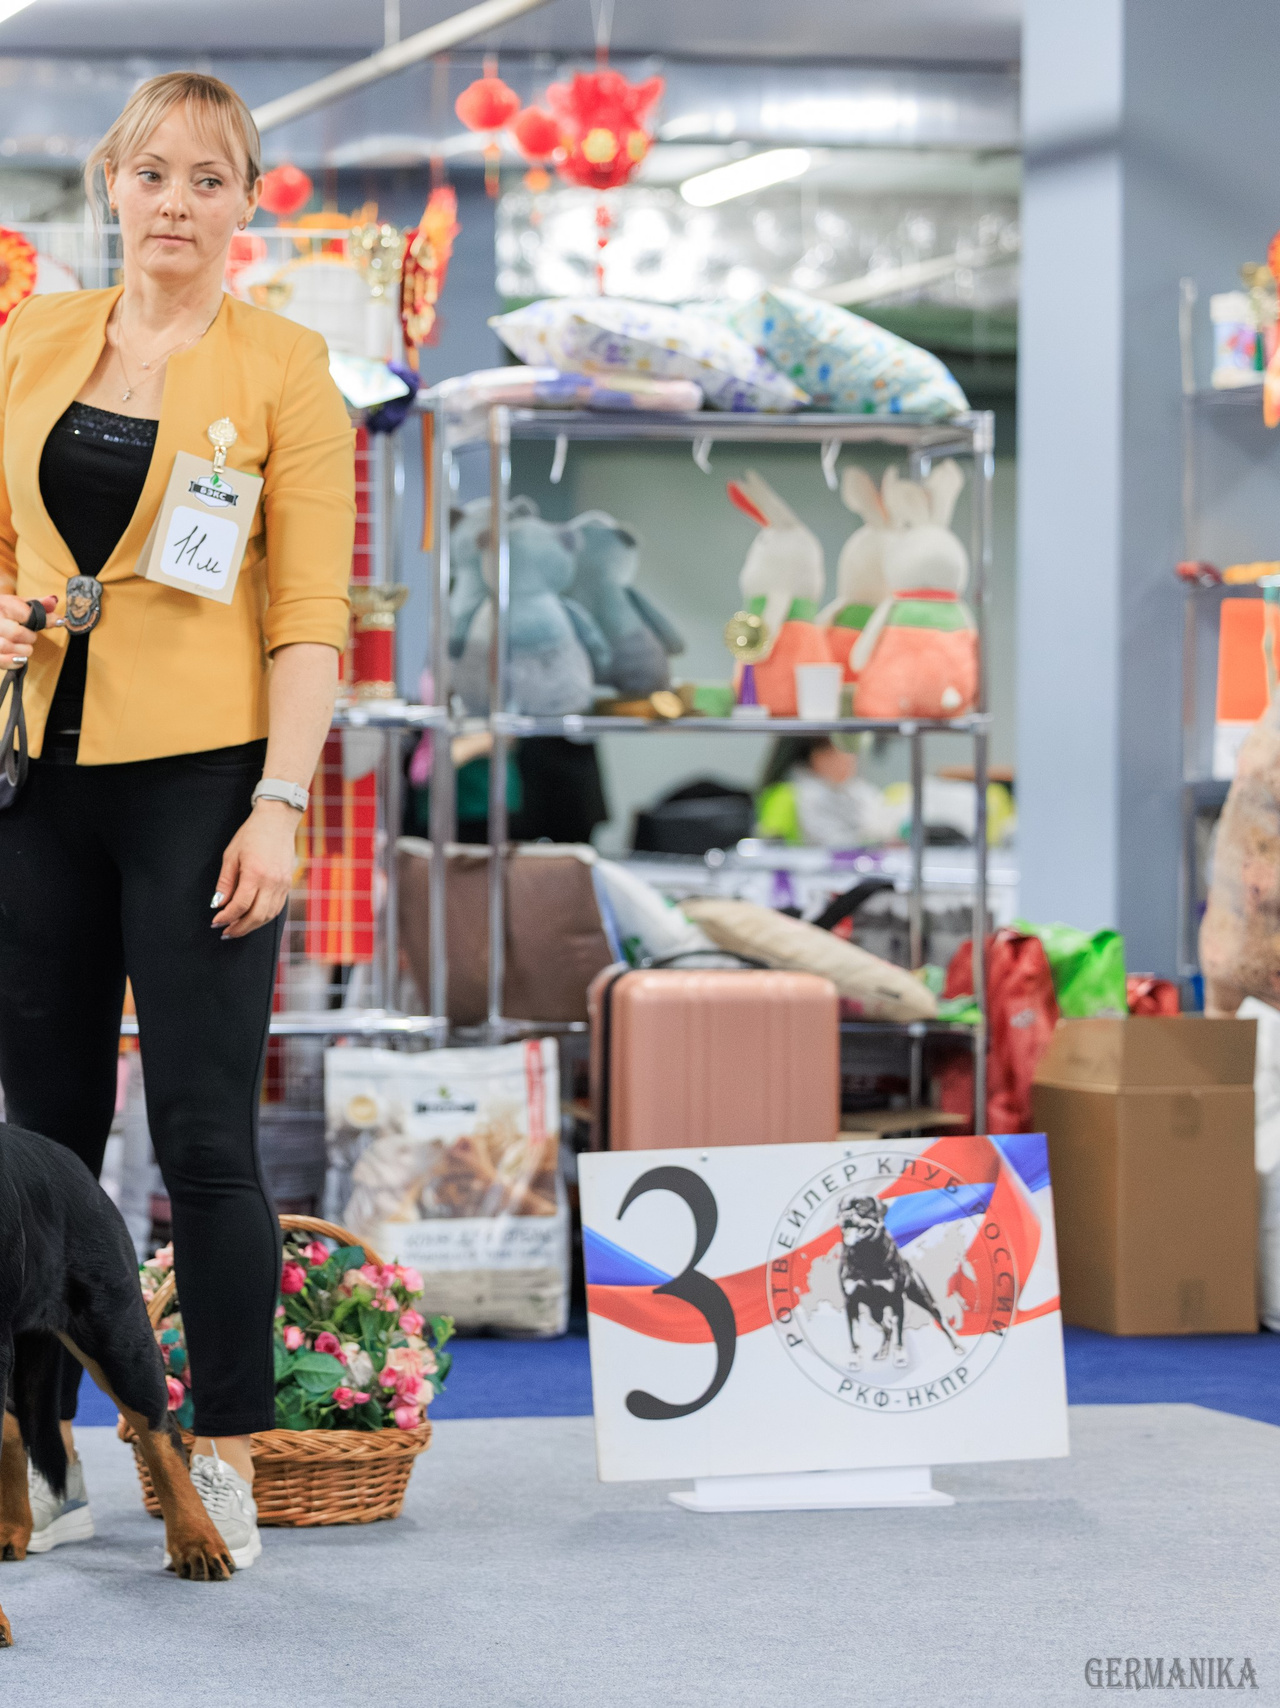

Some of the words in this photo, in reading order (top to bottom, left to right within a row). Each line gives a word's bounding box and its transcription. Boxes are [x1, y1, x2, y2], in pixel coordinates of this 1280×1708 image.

[616, 1165, 737, 1421] 3
[771, 1164, 857, 1348] РОТВЕЙЛЕР
[877, 1157, 960, 1195] КЛУБ
[969, 1202, 1015, 1338] РОССИИ
[837, 1366, 969, 1408] РКФ-НКПР
